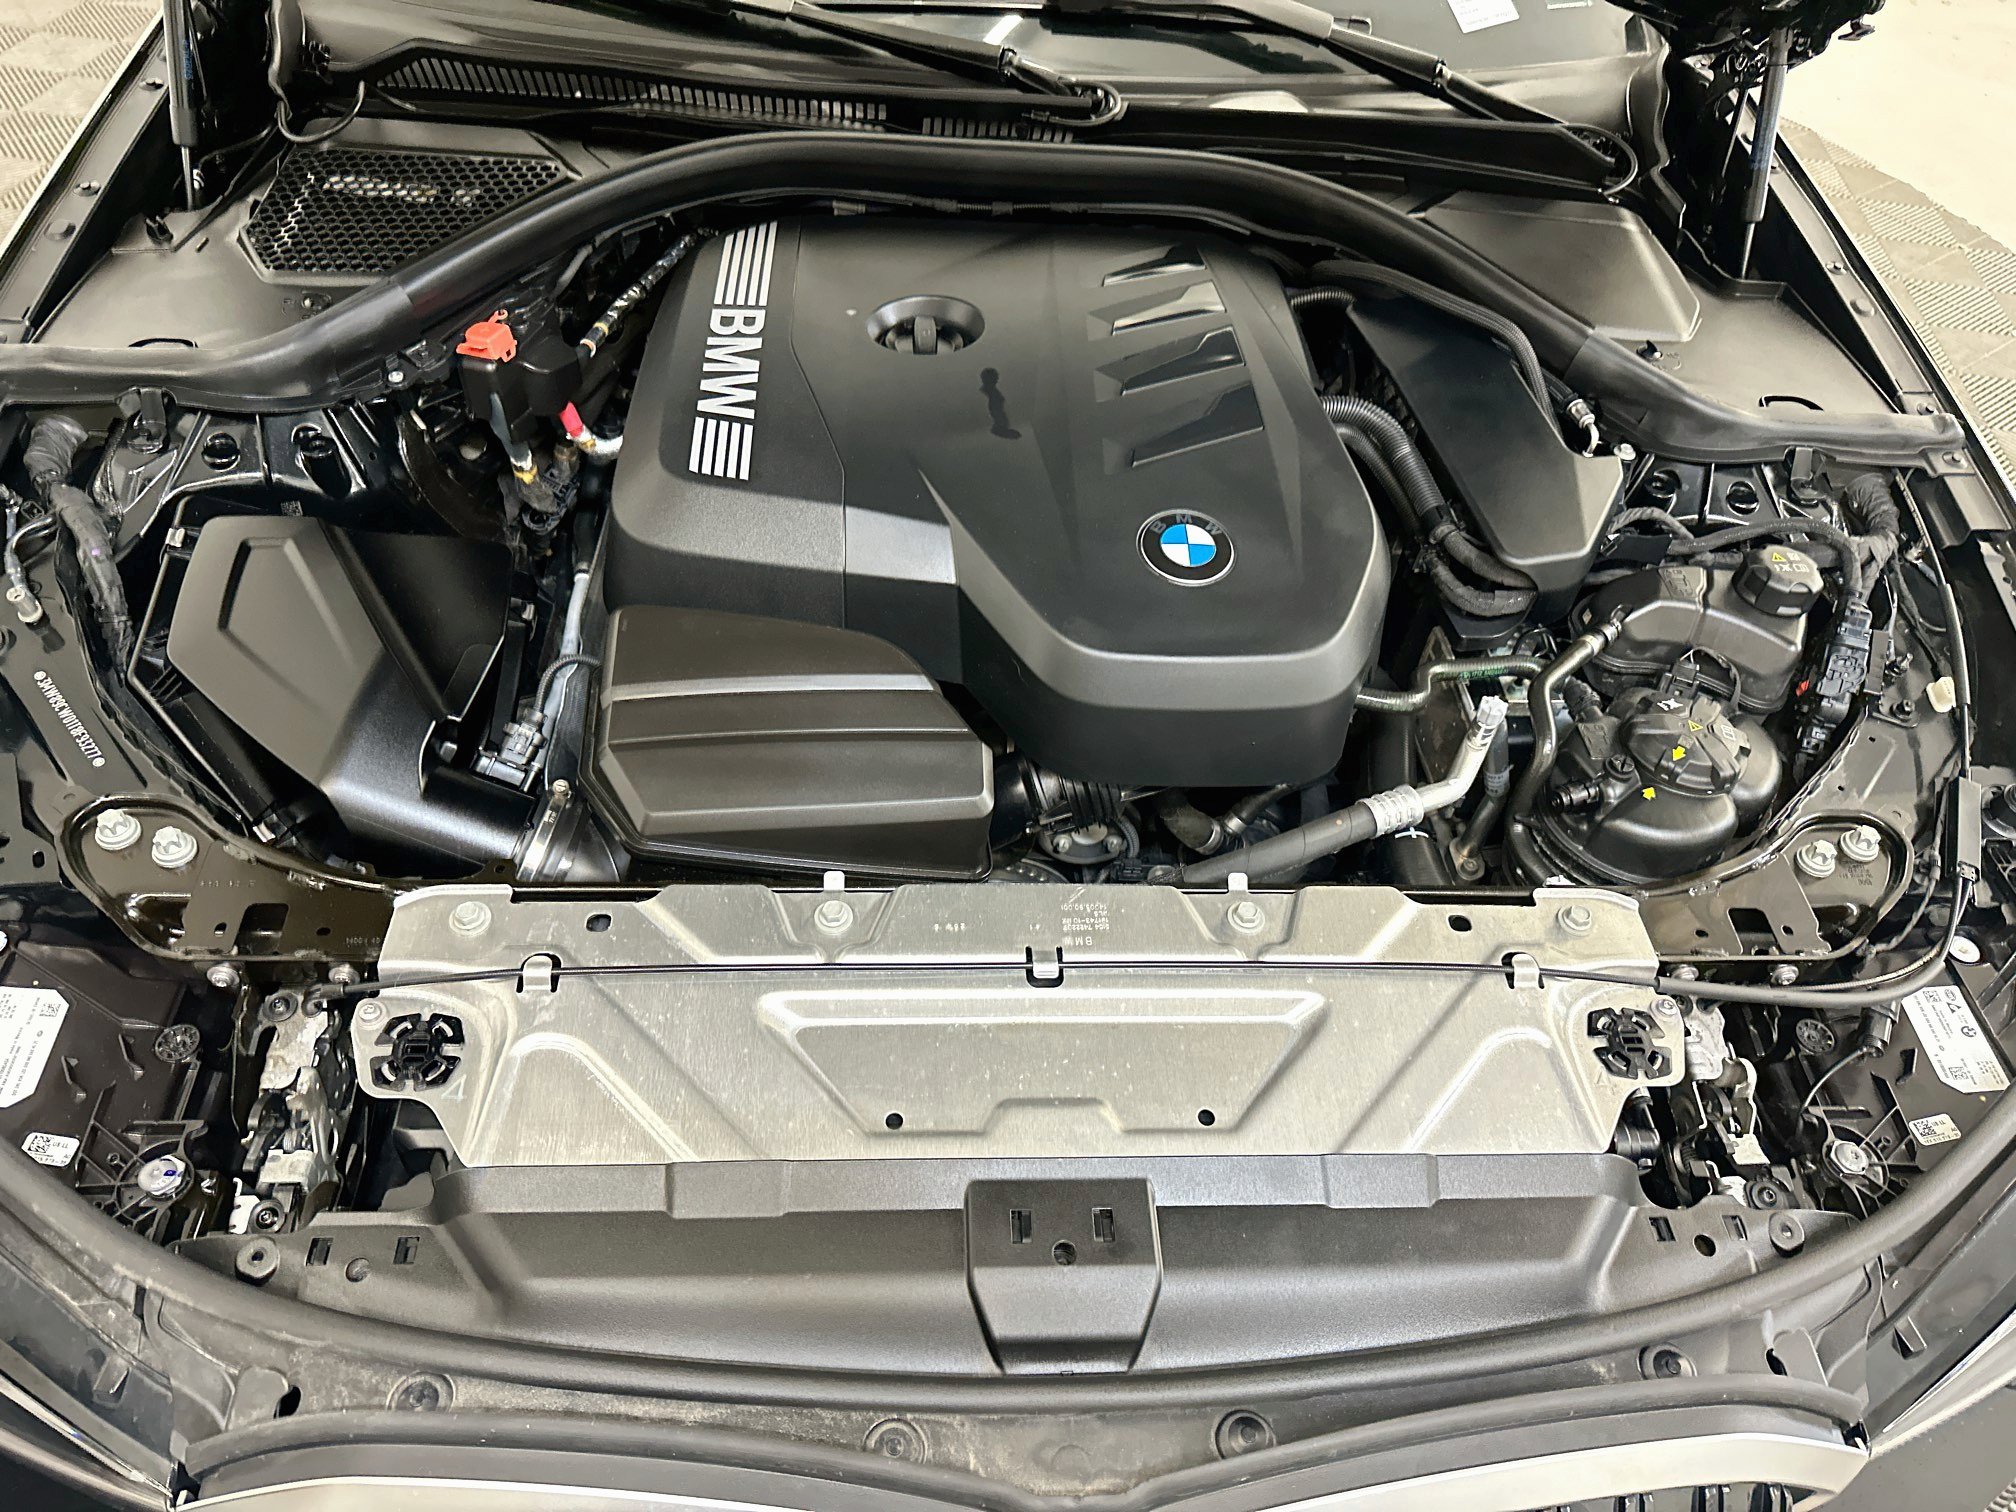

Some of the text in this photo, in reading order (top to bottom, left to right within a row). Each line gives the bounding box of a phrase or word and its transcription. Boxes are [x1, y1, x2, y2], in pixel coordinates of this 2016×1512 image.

[697, 308, 766, 420] BMW
[1150, 513, 1222, 536] BMW
[1062, 936, 1093, 946] BMW
